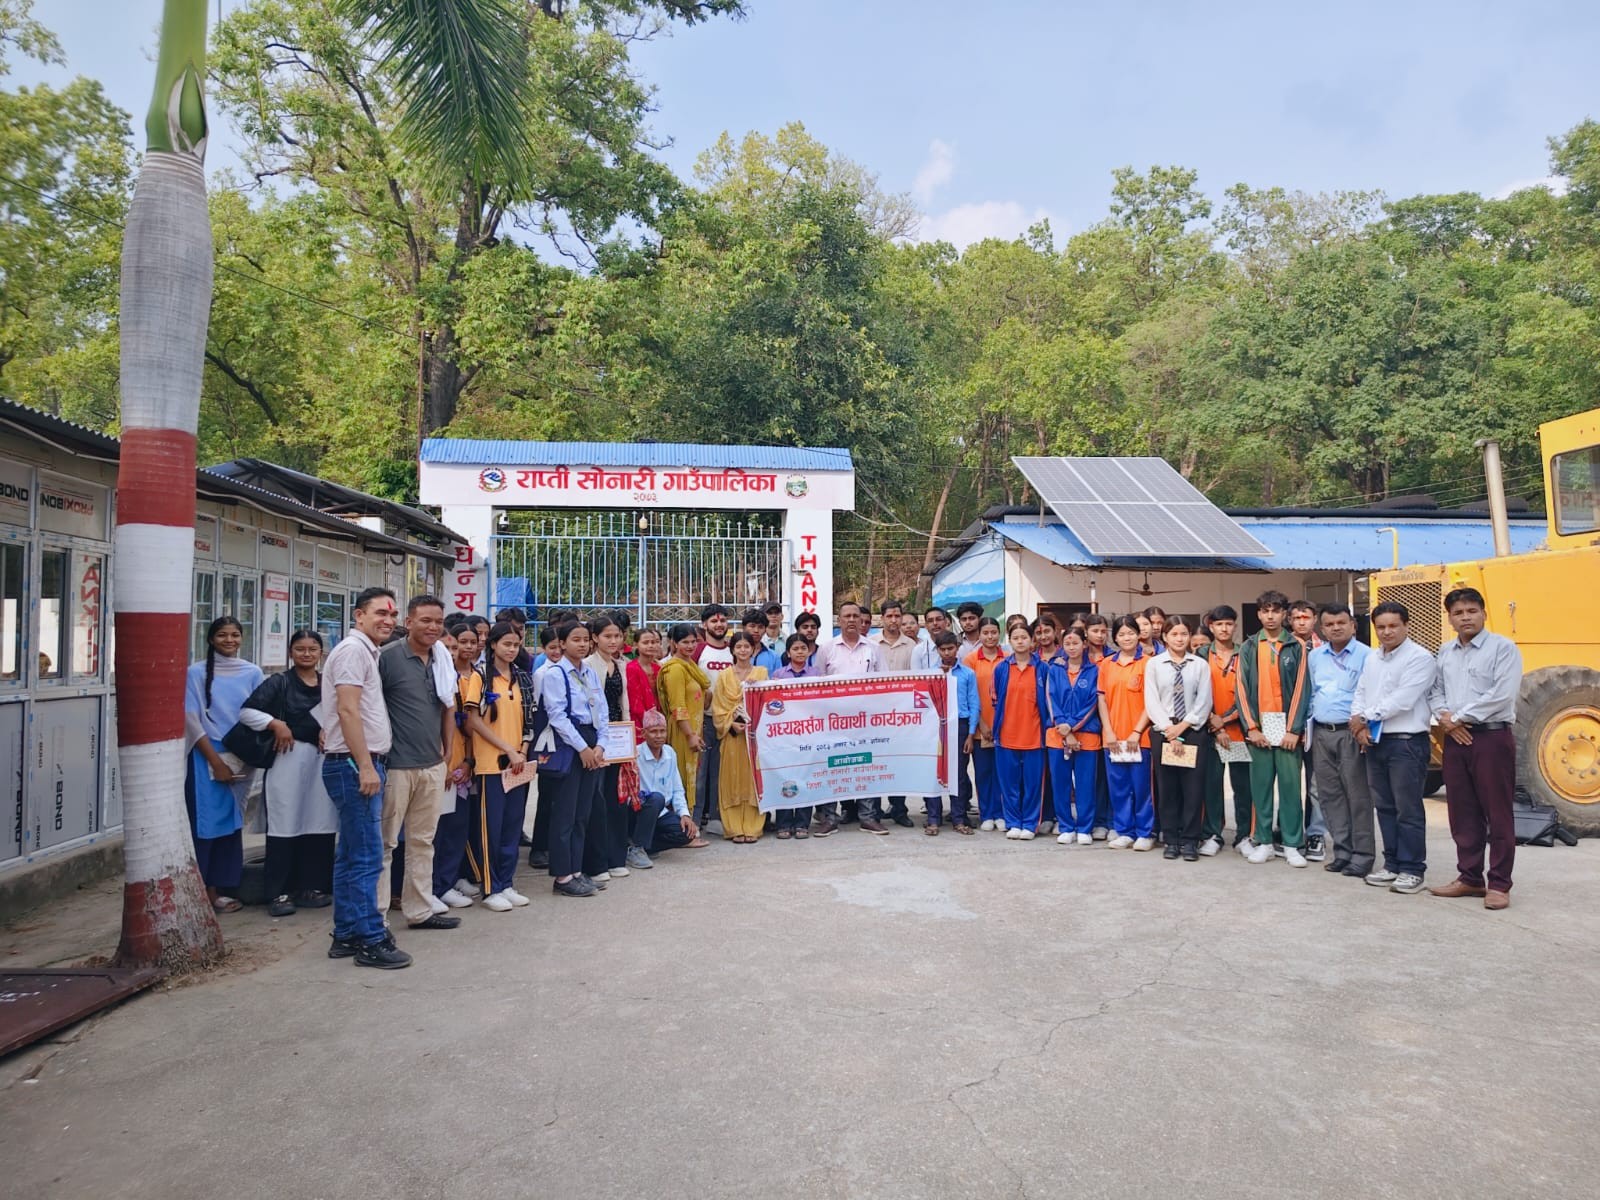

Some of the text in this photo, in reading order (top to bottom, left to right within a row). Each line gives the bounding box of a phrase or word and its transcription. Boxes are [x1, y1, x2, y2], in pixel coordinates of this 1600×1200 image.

[516, 465, 777, 493] राप्ती सोनारी गाउँपालिका
[0, 482, 29, 502] BOND
[41, 493, 94, 515] PROXIBON
[870, 709, 923, 727] कार्यक्रम
